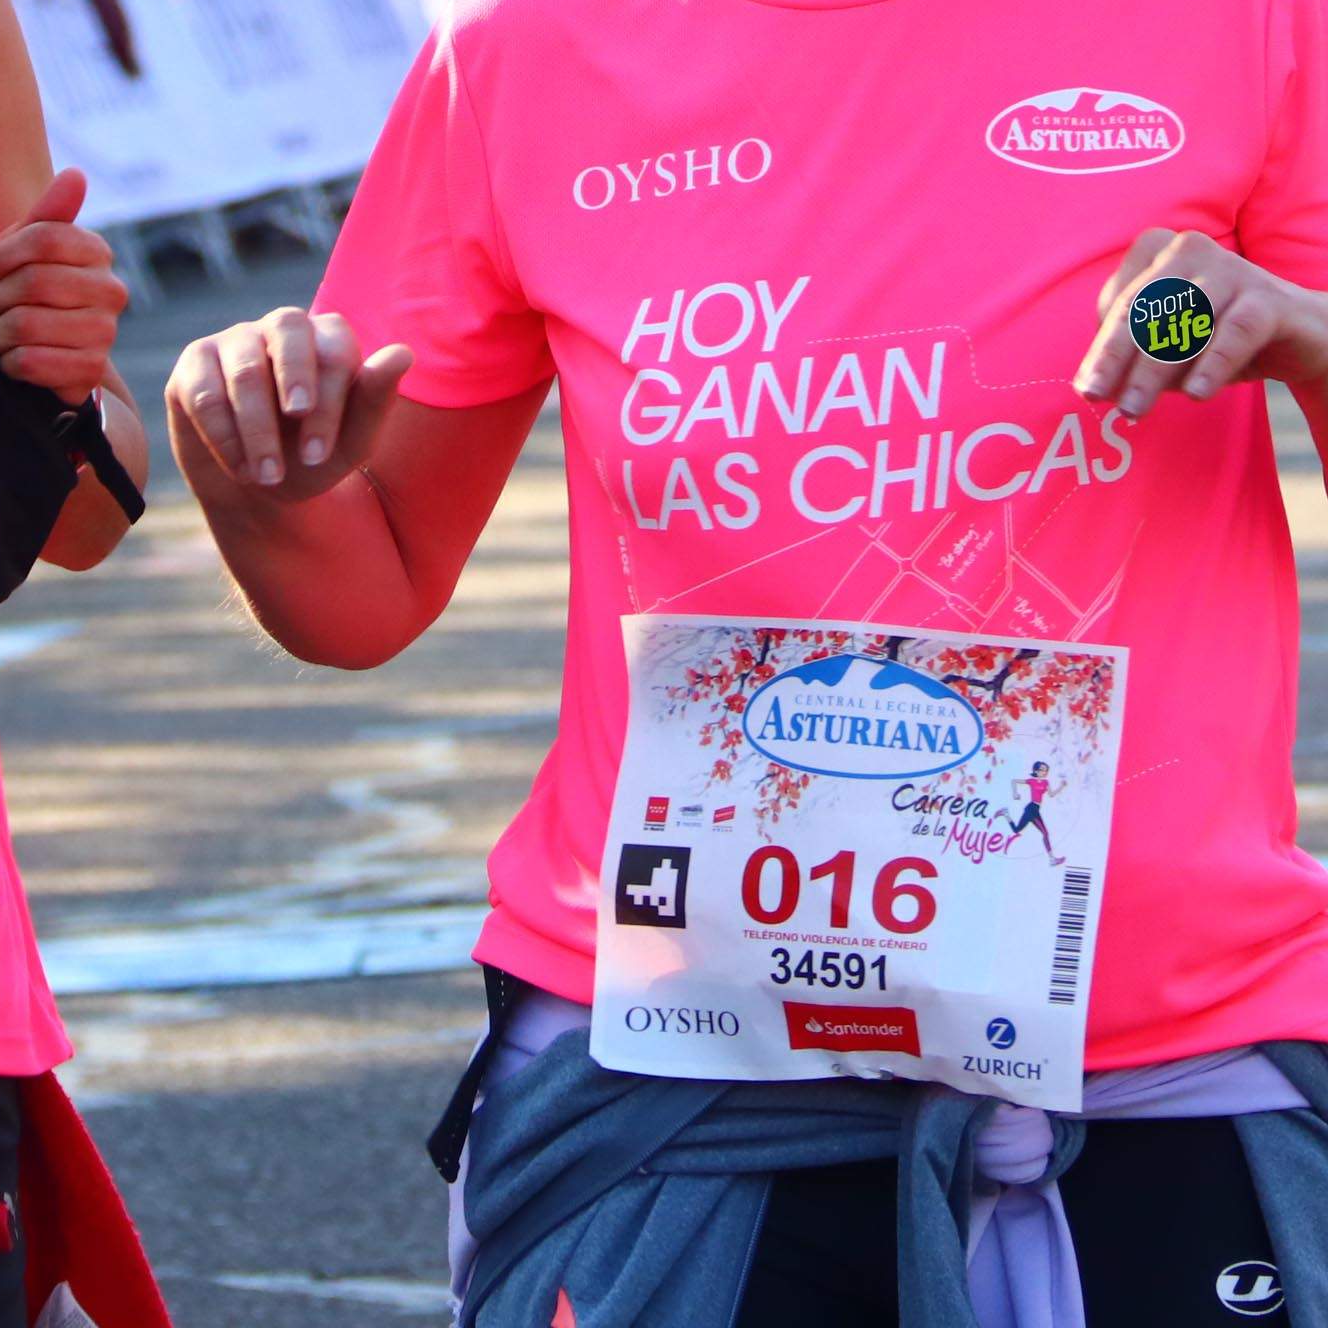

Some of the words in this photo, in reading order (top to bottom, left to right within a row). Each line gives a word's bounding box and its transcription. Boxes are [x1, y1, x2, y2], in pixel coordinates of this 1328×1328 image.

[1001, 118, 1171, 152] ASTURIANA
[1032, 115, 1095, 127] CENTRAL
[572, 137, 772, 211] OYSHO
[620, 275, 812, 365] HOY
[619, 341, 947, 447] GANAN
[621, 452, 761, 532] LAS
[788, 409, 1138, 525] CHICAS
[757, 695, 962, 755] ASTURIANA
[794, 693, 866, 709] CENTRAL
[874, 700, 958, 719] LECHERA
[891, 783, 989, 819] Carrera
[911, 821, 929, 836] de
[933, 816, 947, 837] la
[941, 817, 1022, 865] Mujer
[741, 845, 939, 935] 016
[742, 928, 799, 942] TELÉFONO
[802, 935, 858, 947] VIOLENCIA
[862, 938, 877, 948] DE
[879, 938, 929, 951] GÉNERO
[770, 947, 887, 991] 34591
[624, 1005, 740, 1037] OYSHO
[824, 1021, 904, 1038] Santander
[962, 1055, 1042, 1080] ZURICH
